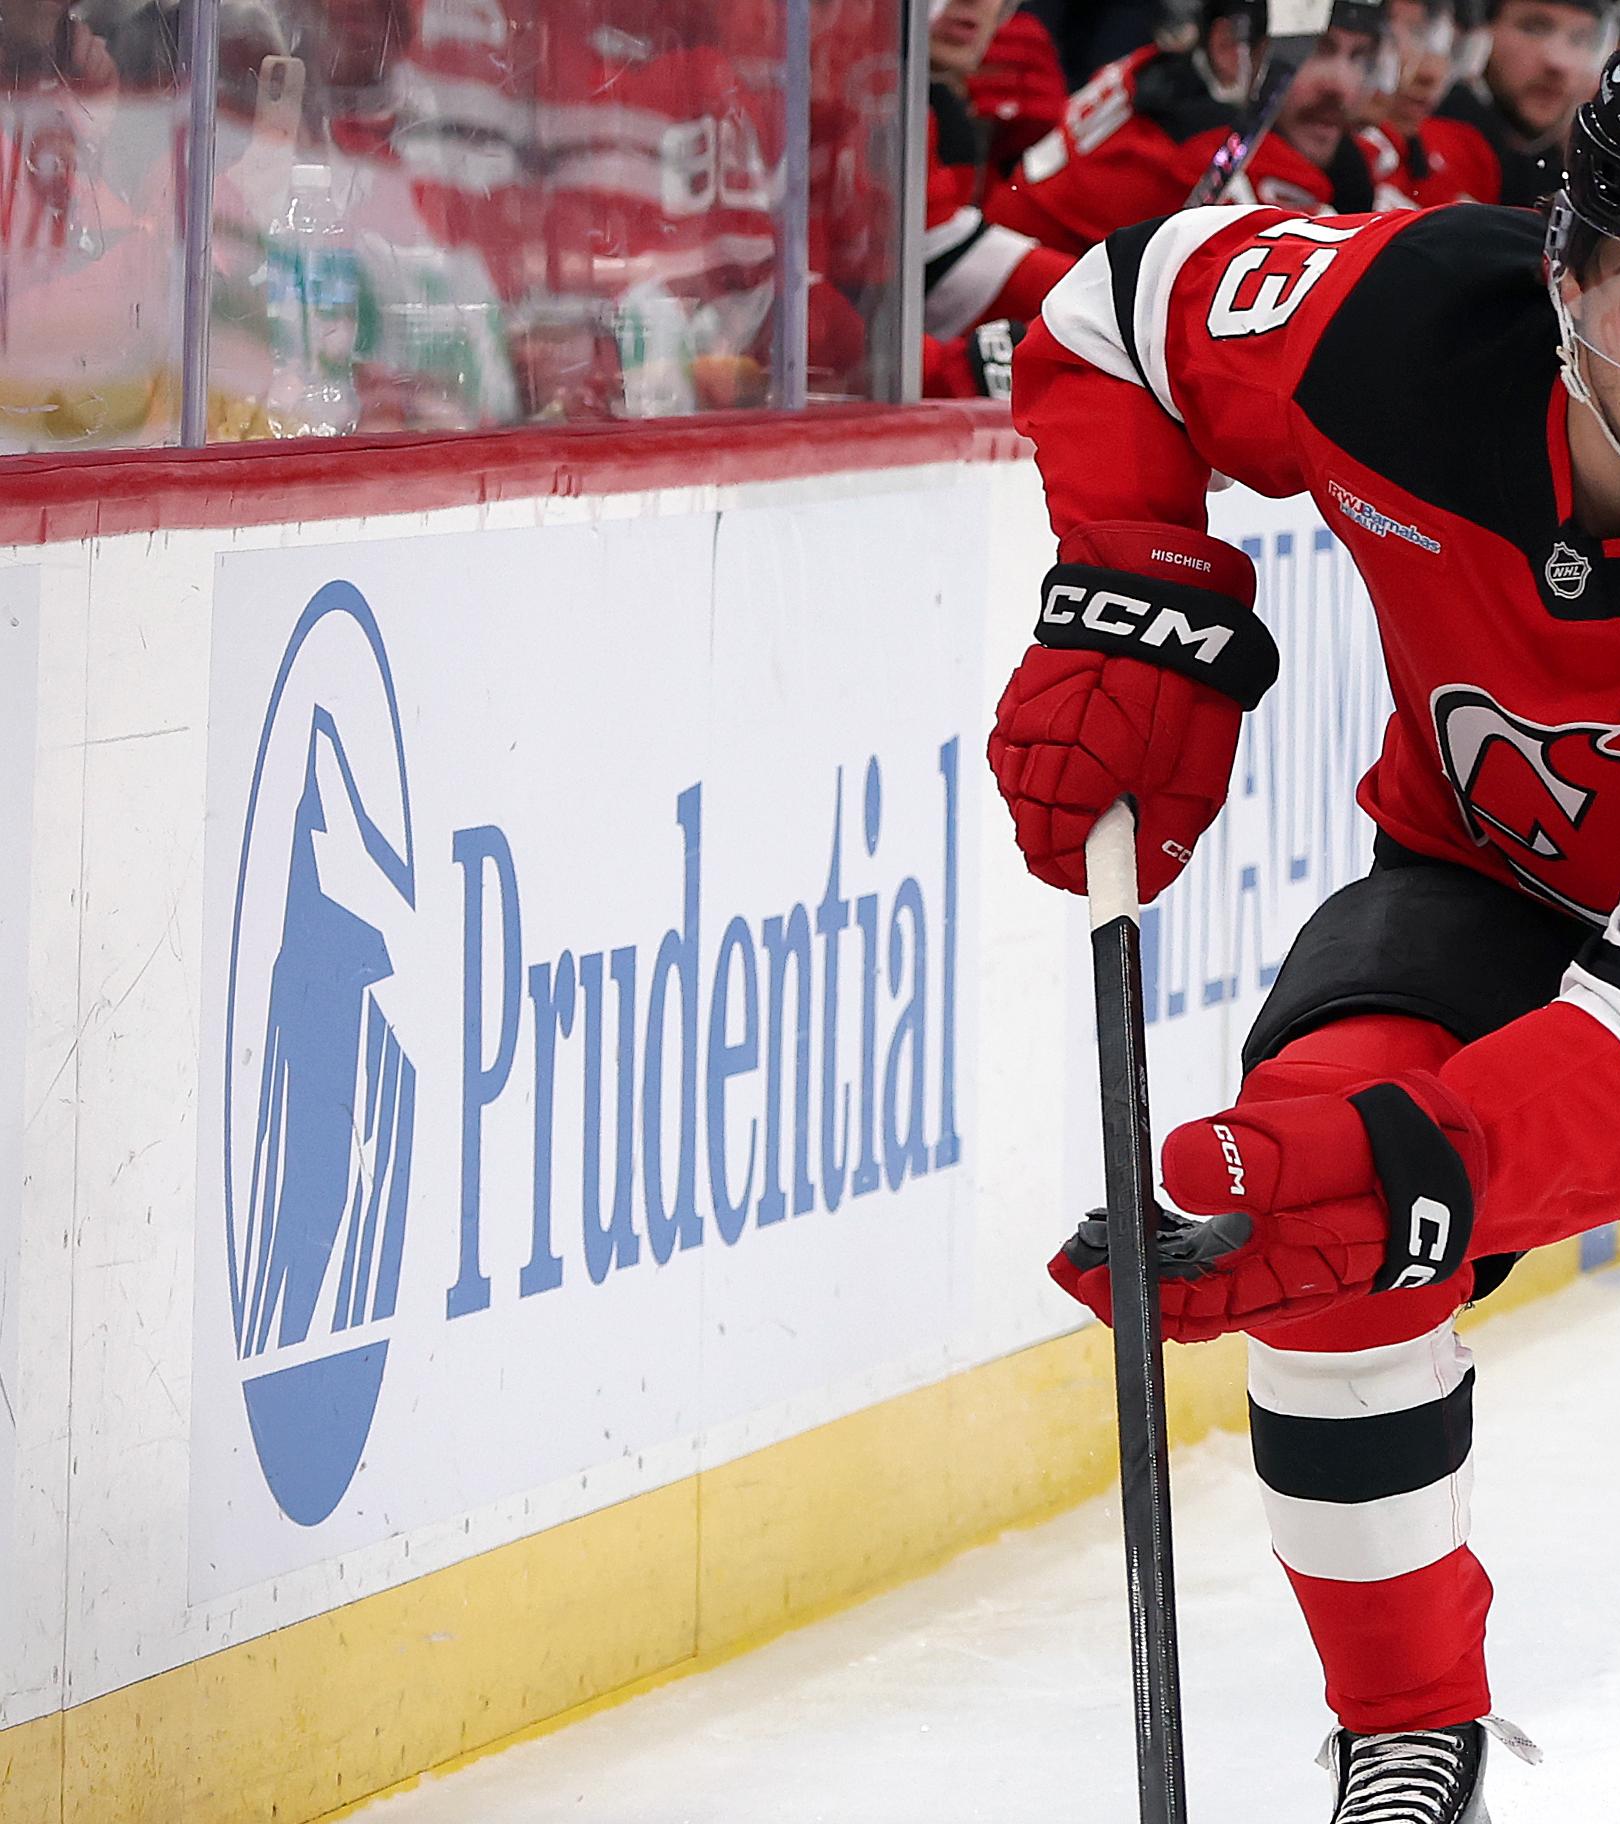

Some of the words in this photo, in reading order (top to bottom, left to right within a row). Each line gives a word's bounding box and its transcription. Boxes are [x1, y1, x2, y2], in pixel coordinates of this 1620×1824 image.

[1207, 217, 1372, 339] 13
[1151, 548, 1212, 573] HISCHIER
[1552, 565, 1580, 578] NHL
[1043, 584, 1235, 664] CCM
[446, 734, 961, 1321] Prudential
[1213, 1124, 1246, 1196] CCM
